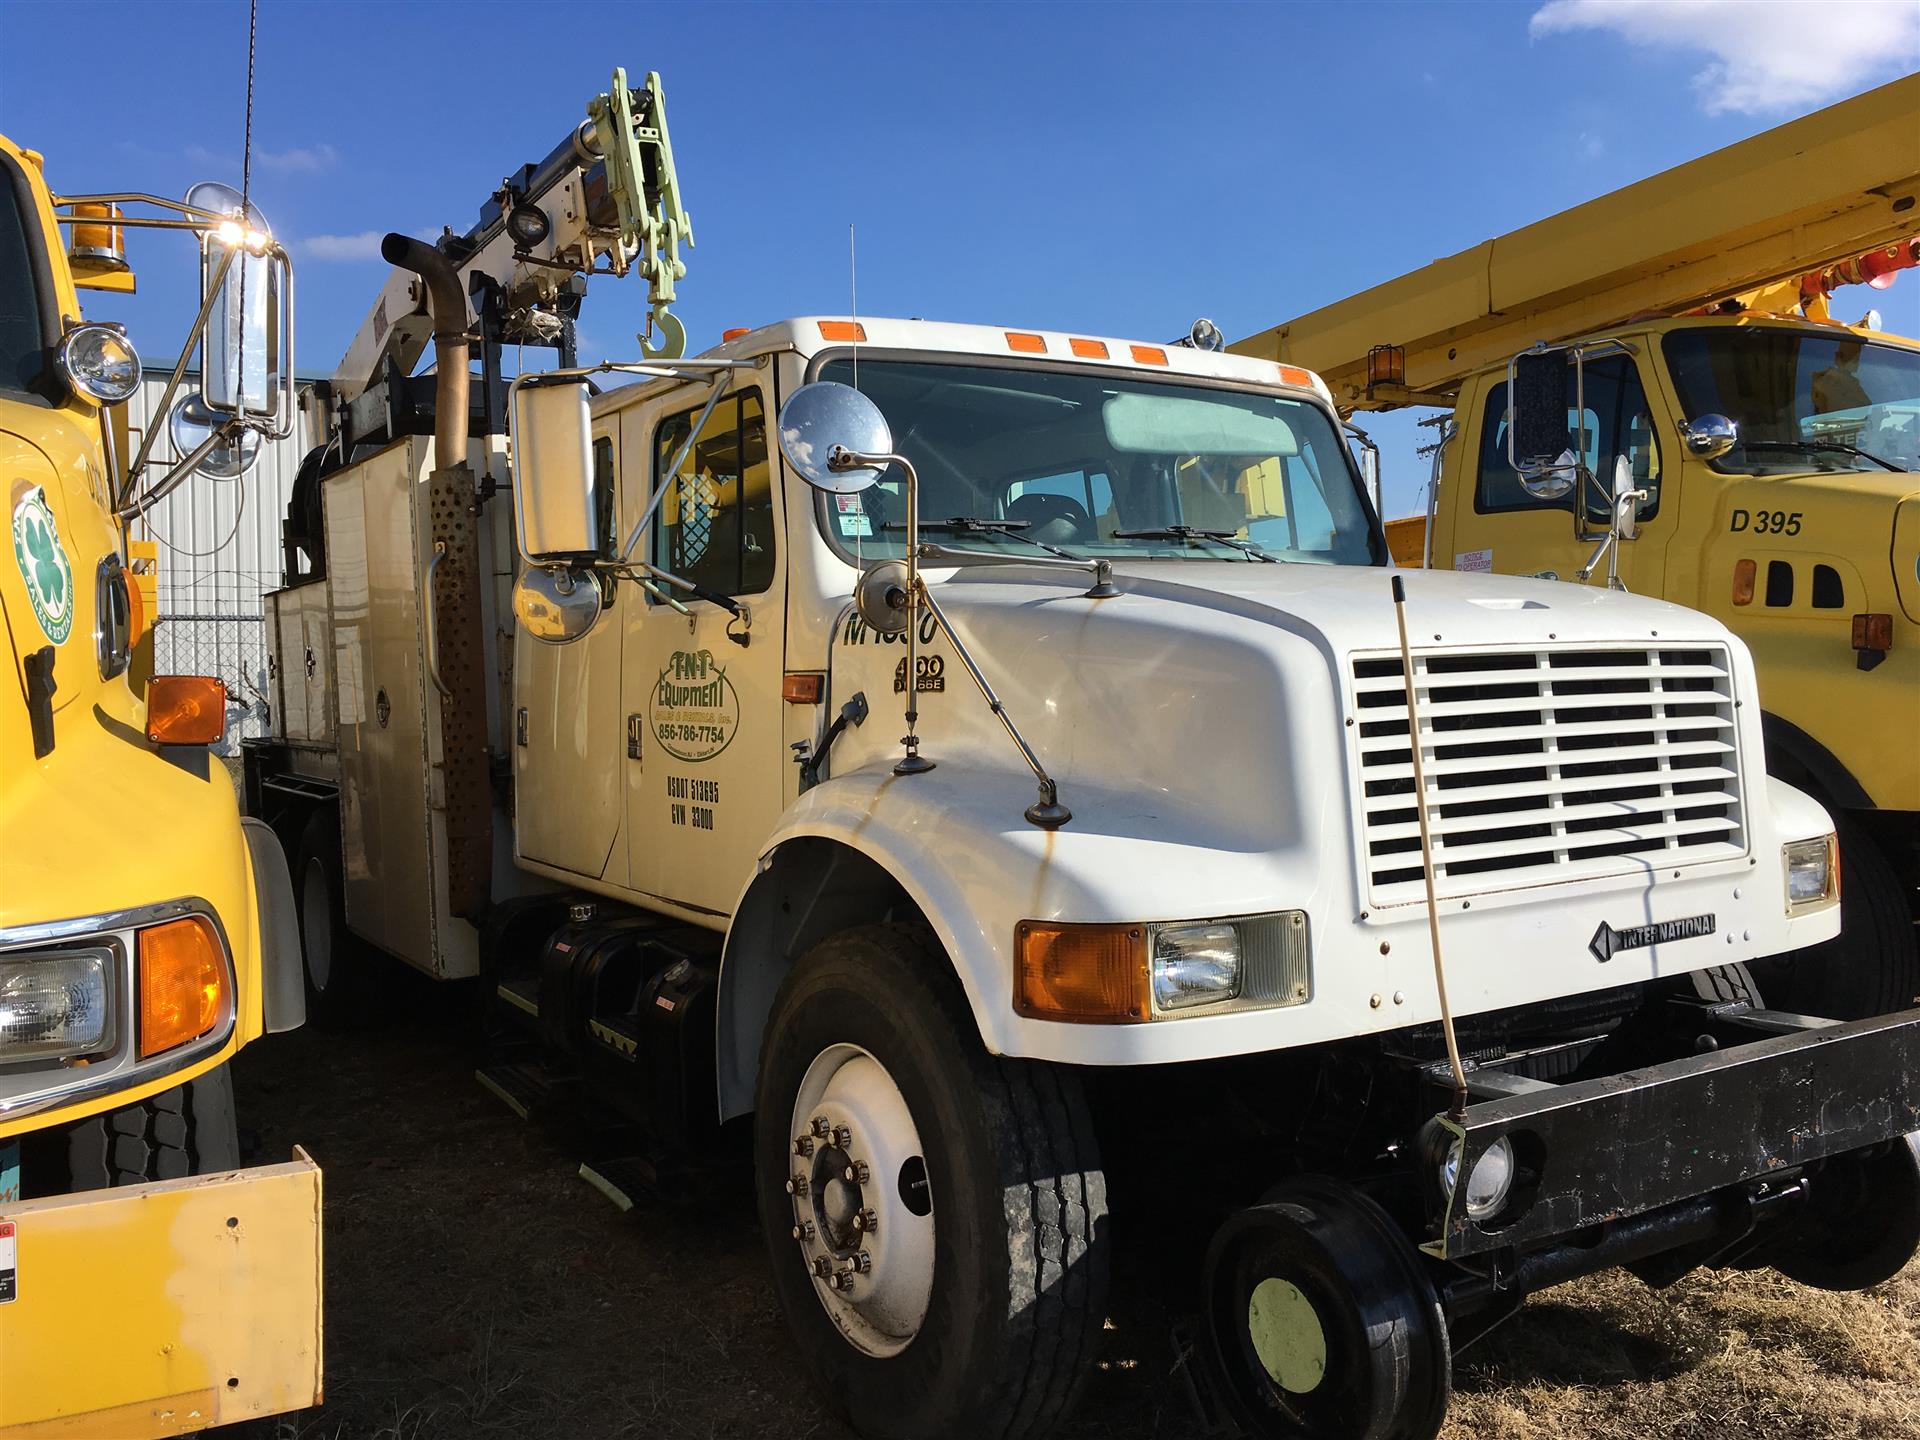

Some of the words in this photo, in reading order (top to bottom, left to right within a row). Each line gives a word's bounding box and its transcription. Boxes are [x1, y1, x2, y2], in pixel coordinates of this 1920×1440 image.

[1730, 509, 1750, 532] D
[1753, 510, 1803, 536] 395
[659, 723, 725, 744] 856-786-7754
[667, 775, 688, 799] USDOT
[691, 779, 719, 803] 513695
[672, 803, 686, 825] GVW
[692, 806, 713, 830] 33000
[1622, 914, 1716, 949] INTERNATIONAL
